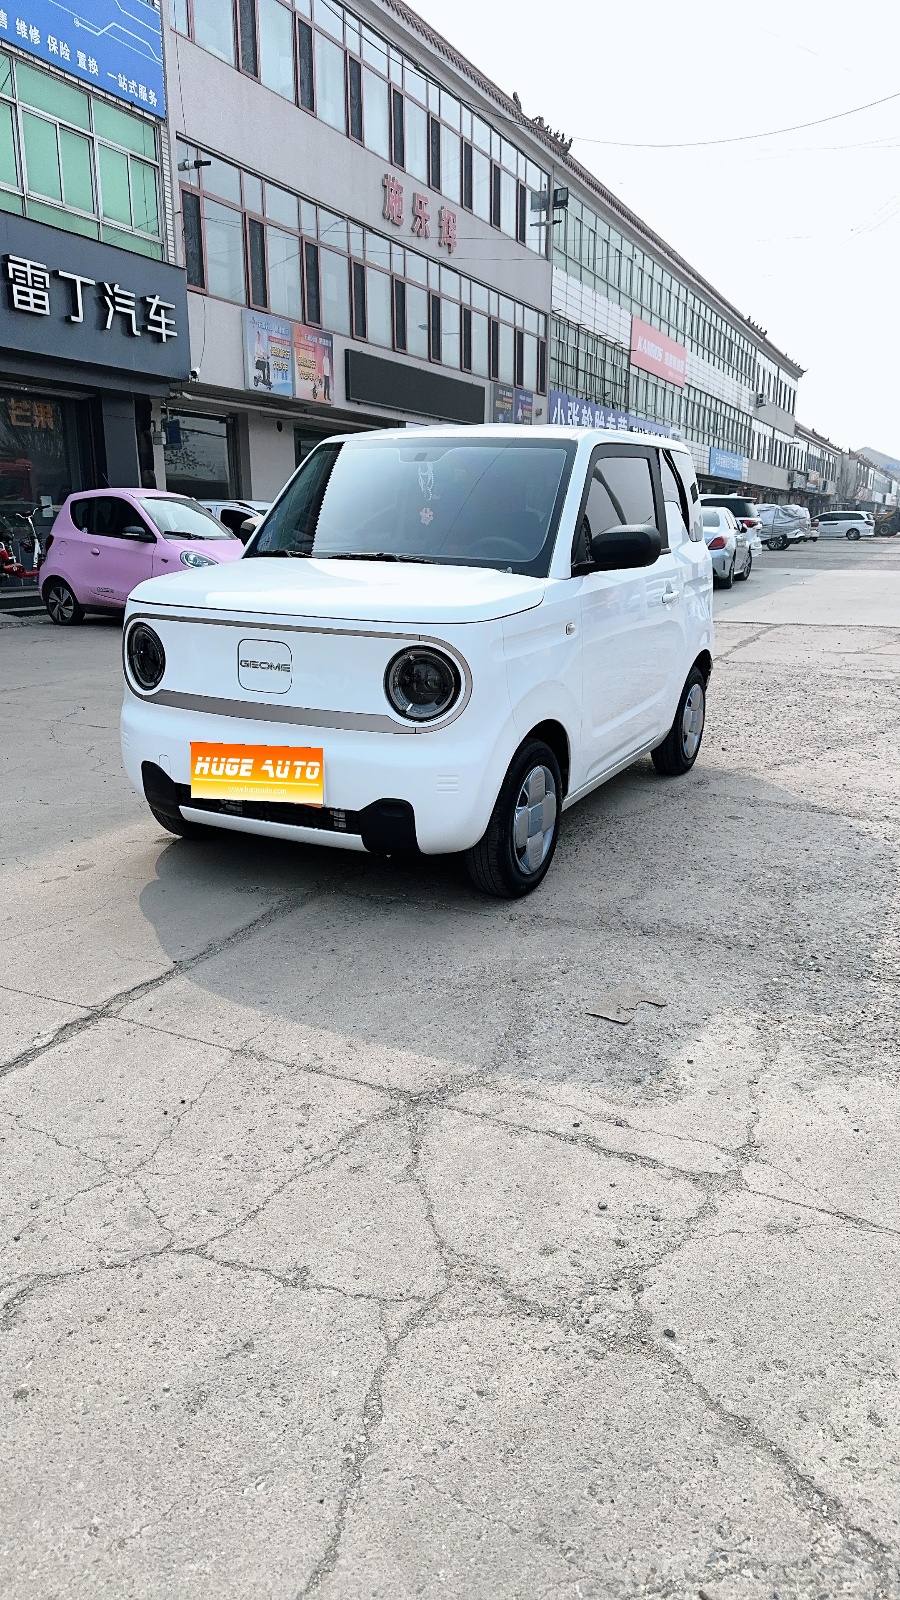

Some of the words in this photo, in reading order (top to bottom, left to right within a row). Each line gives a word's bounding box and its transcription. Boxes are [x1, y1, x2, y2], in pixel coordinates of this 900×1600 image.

[16, 18, 41, 45] 维修
[47, 35, 71, 62] 保险
[76, 50, 99, 77] 置换
[107, 72, 158, 108] 一站式服务
[382, 173, 457, 254] 施乐辉
[7, 254, 178, 343] 雷丁汽车
[552, 398, 628, 430] 小张轮胎专营
[240, 659, 291, 673] GEOME
